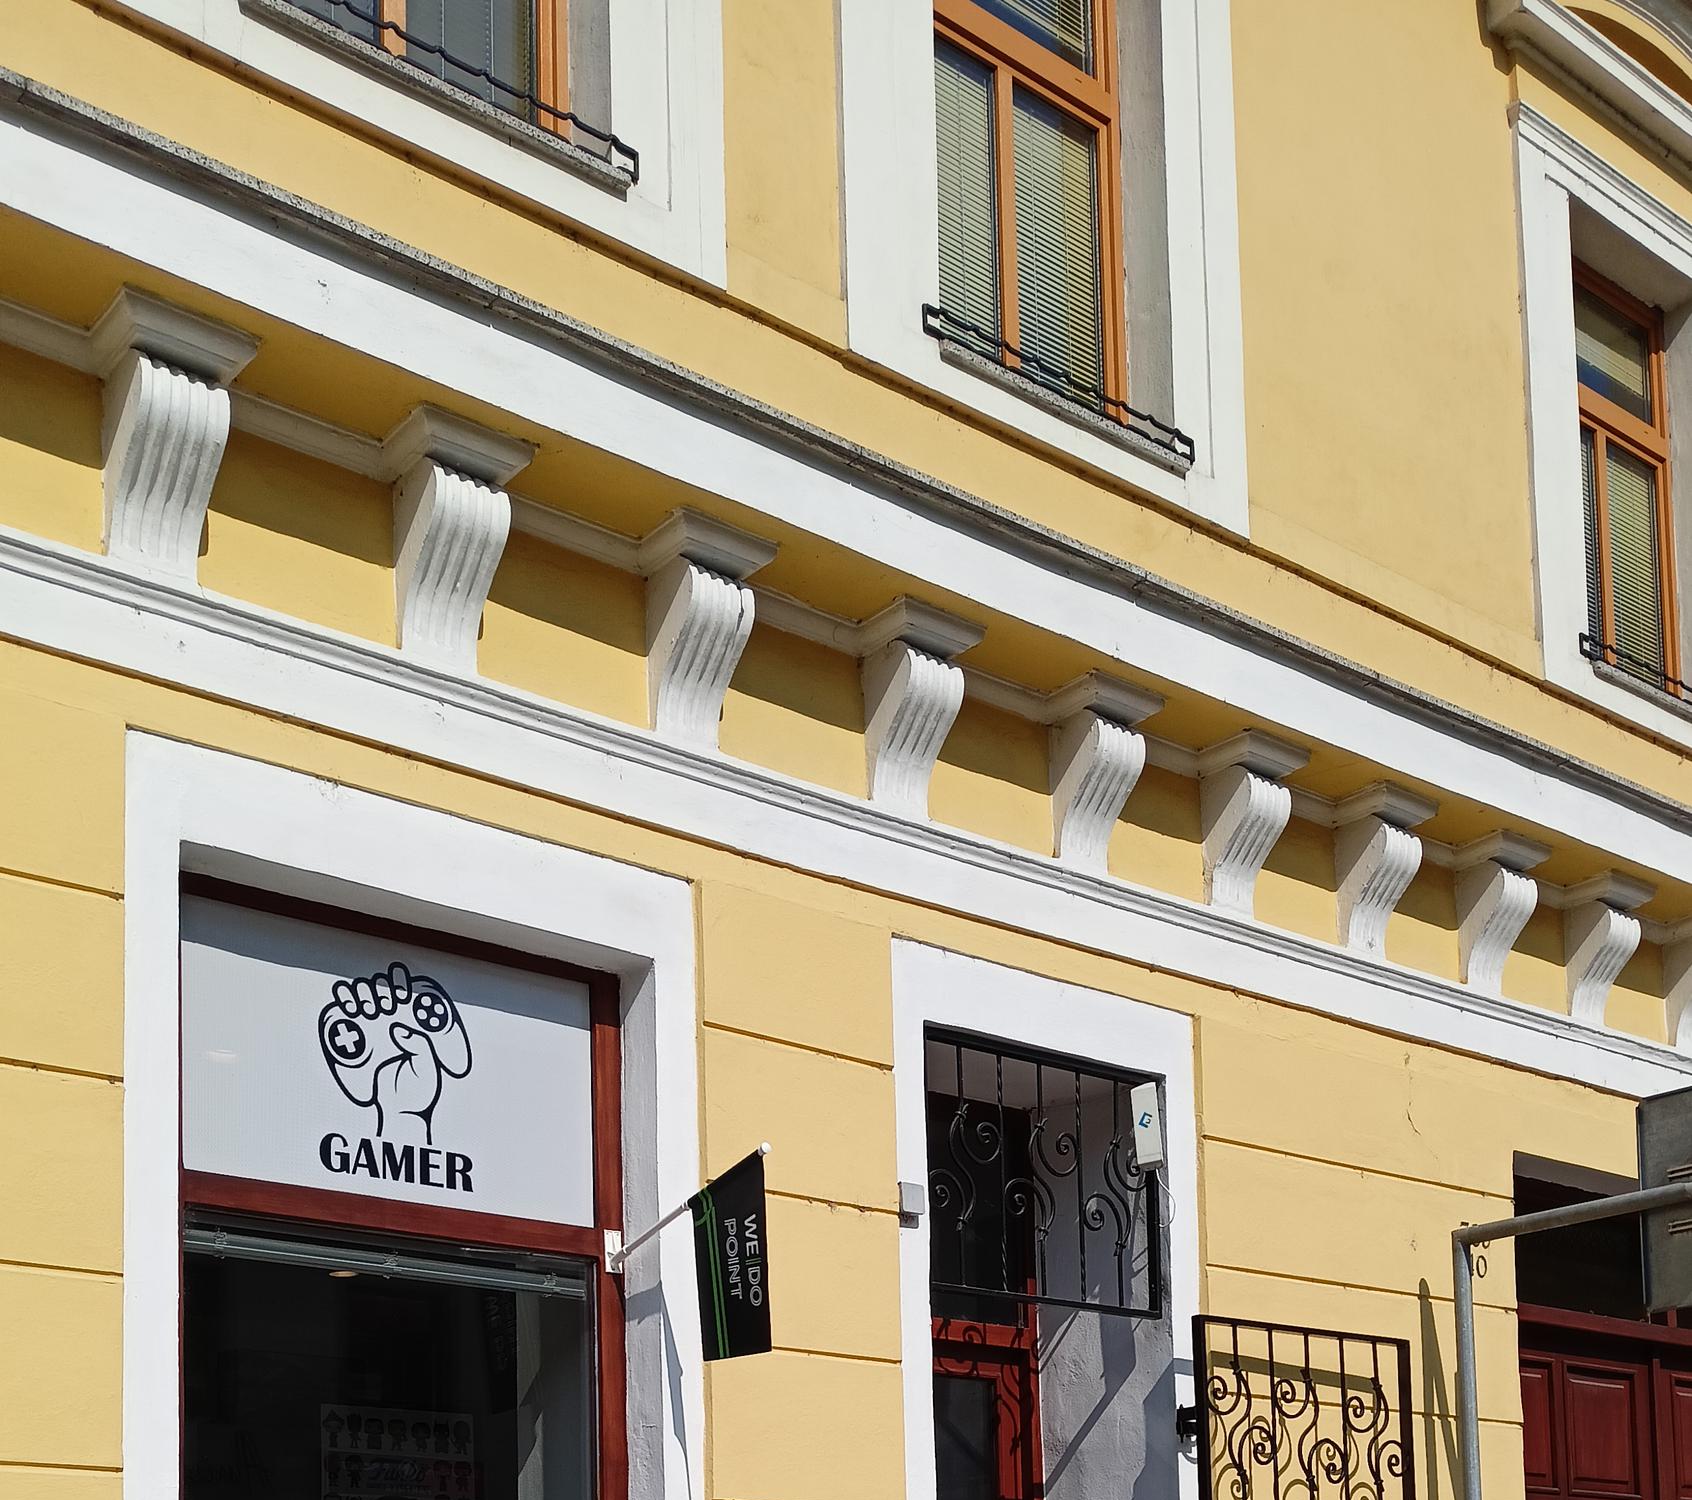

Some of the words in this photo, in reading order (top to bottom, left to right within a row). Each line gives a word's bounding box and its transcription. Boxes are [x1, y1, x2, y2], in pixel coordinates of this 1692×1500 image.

[319, 1133, 474, 1192] GAMER
[724, 1218, 743, 1300] POINT
[1470, 1253, 1488, 1279] 0
